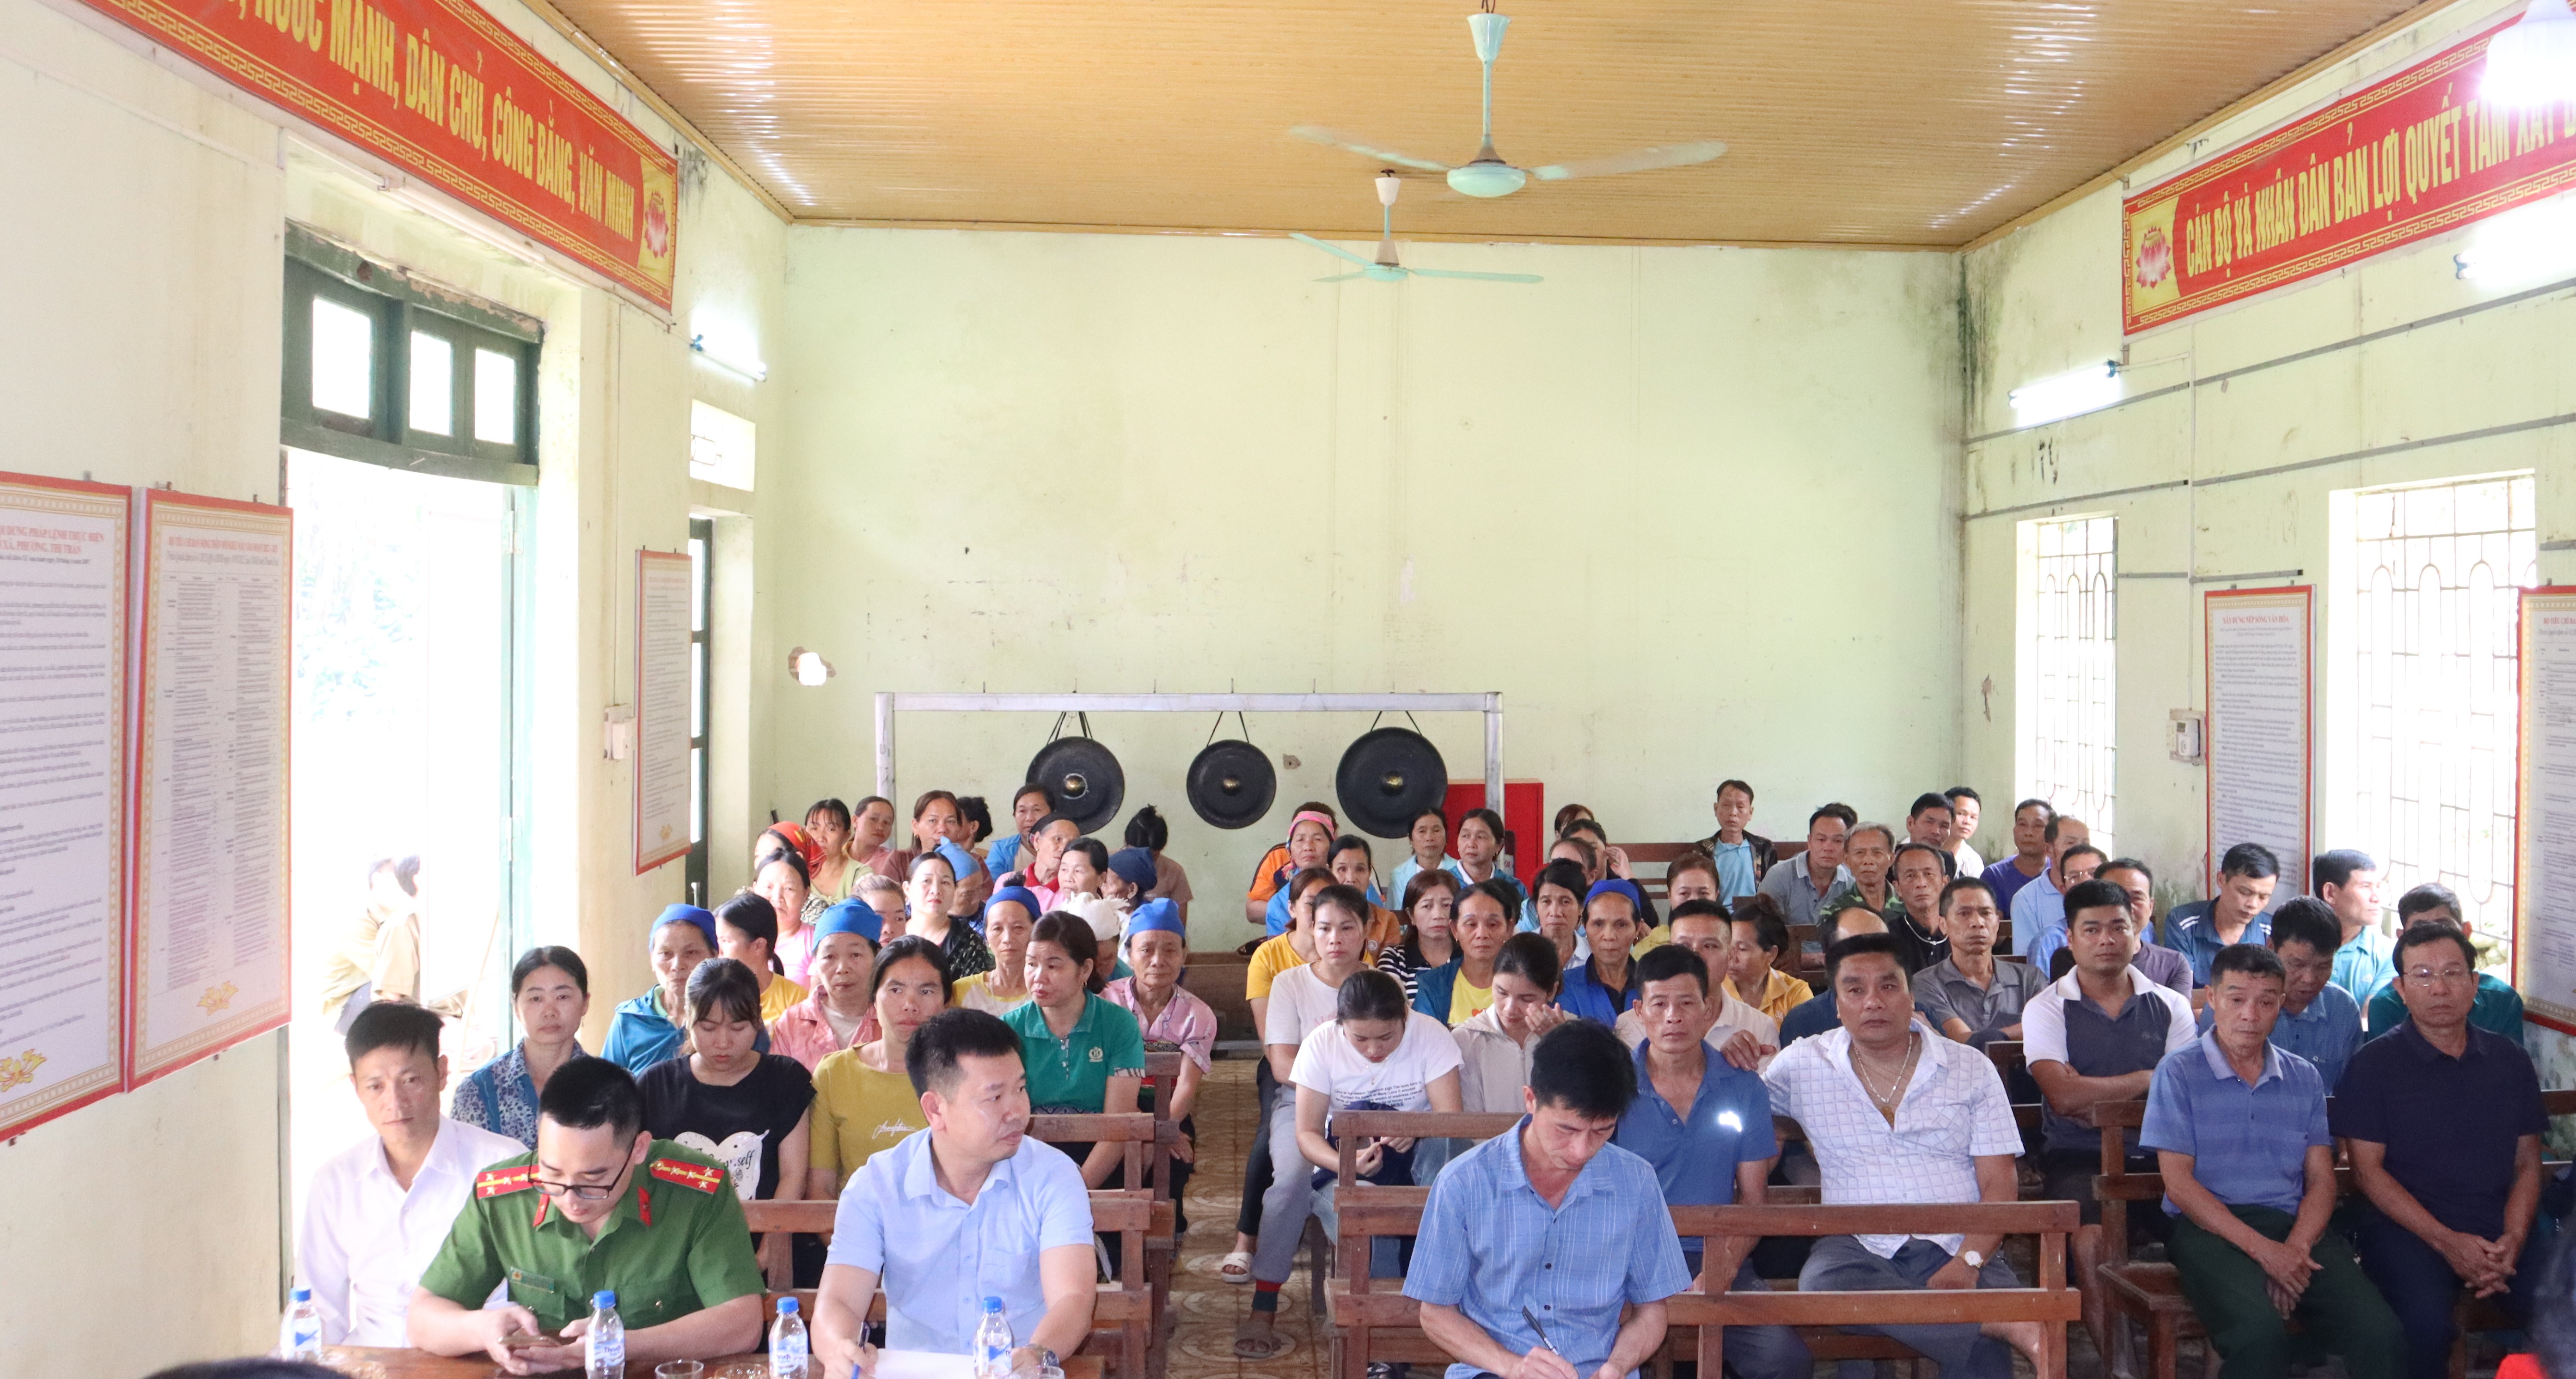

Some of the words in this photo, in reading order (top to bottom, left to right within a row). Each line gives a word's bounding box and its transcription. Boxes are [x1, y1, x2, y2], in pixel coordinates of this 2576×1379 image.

[329, 0, 399, 110] MẠNH,
[405, 28, 445, 127] DÂN
[448, 49, 487, 162] CHỦ,
[492, 85, 533, 180] CÔNG
[536, 98, 575, 214] BẰNG,
[579, 143, 604, 223] VĂN
[604, 169, 635, 242] MINH
[2186, 202, 2212, 278] CÁN
[2214, 190, 2233, 278] BỘ
[2234, 182, 2253, 260] VÀ
[2255, 167, 2296, 253] NHÂN
[2298, 153, 2331, 237] DÂN
[2333, 121, 2369, 224] BẢN
[2373, 128, 2401, 222] LỢI
[2405, 81, 2462, 205] QUYẾT
